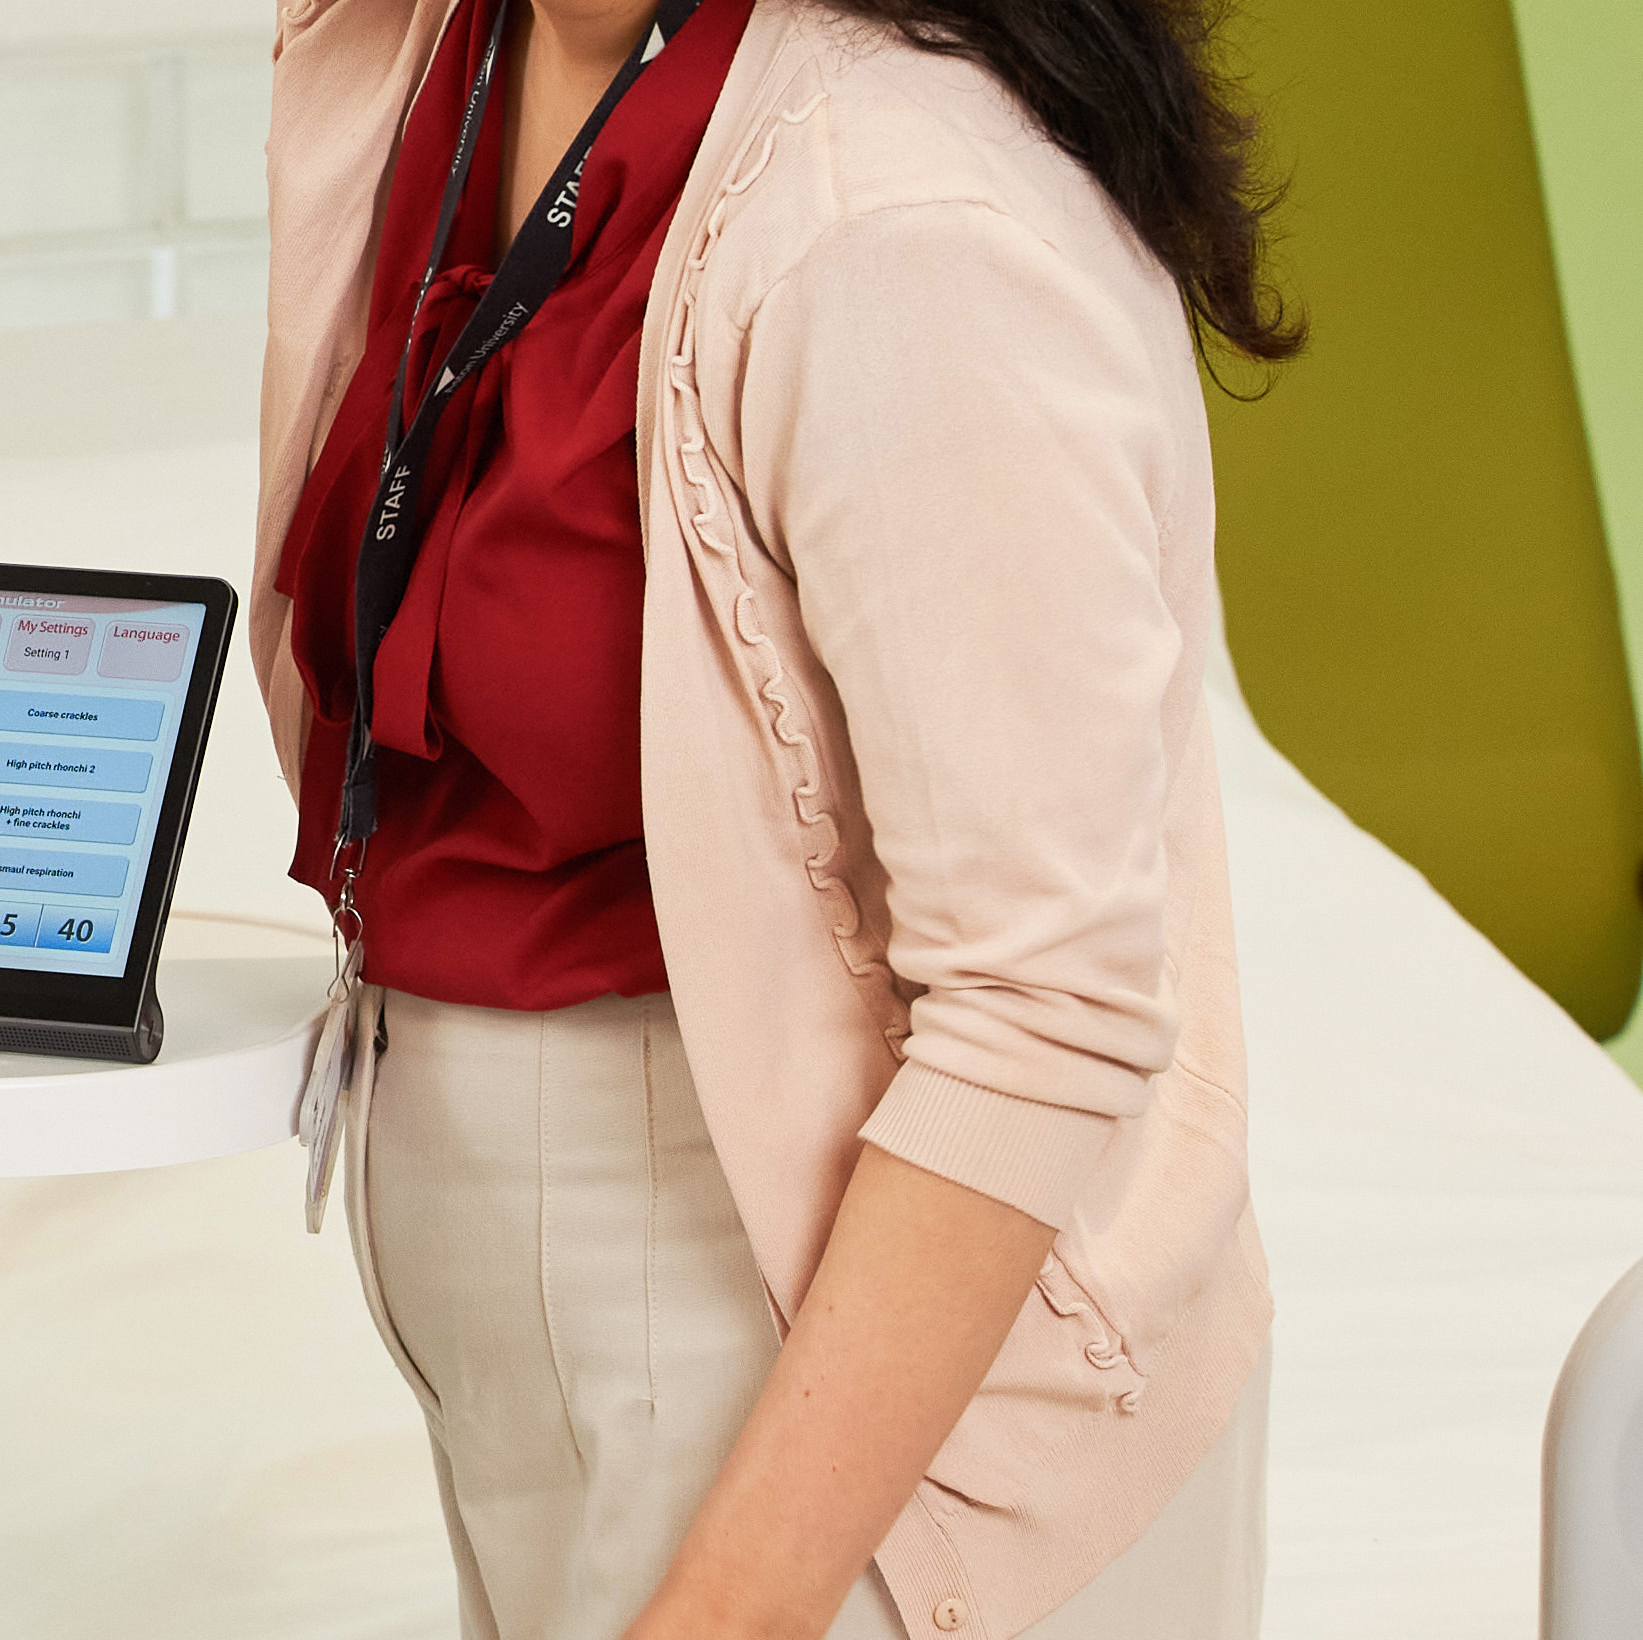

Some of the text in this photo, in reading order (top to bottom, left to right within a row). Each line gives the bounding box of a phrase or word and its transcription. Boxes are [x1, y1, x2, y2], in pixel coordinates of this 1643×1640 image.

[469, 301, 529, 360] University
[376, 465, 411, 541] STAFF
[17, 619, 88, 637] My Settings
[113, 626, 180, 643] Language
[24, 646, 70, 661] Setting 1
[27, 709, 98, 721] Coarse crackles
[6, 759, 96, 774] High pitch rhonchi 2
[0, 805, 81, 820] High pitch rhonchi
[13, 818, 31, 828] fine
[32, 820, 70, 831] crackles
[26, 866, 74, 878] respiration
[57, 917, 94, 942] 40
